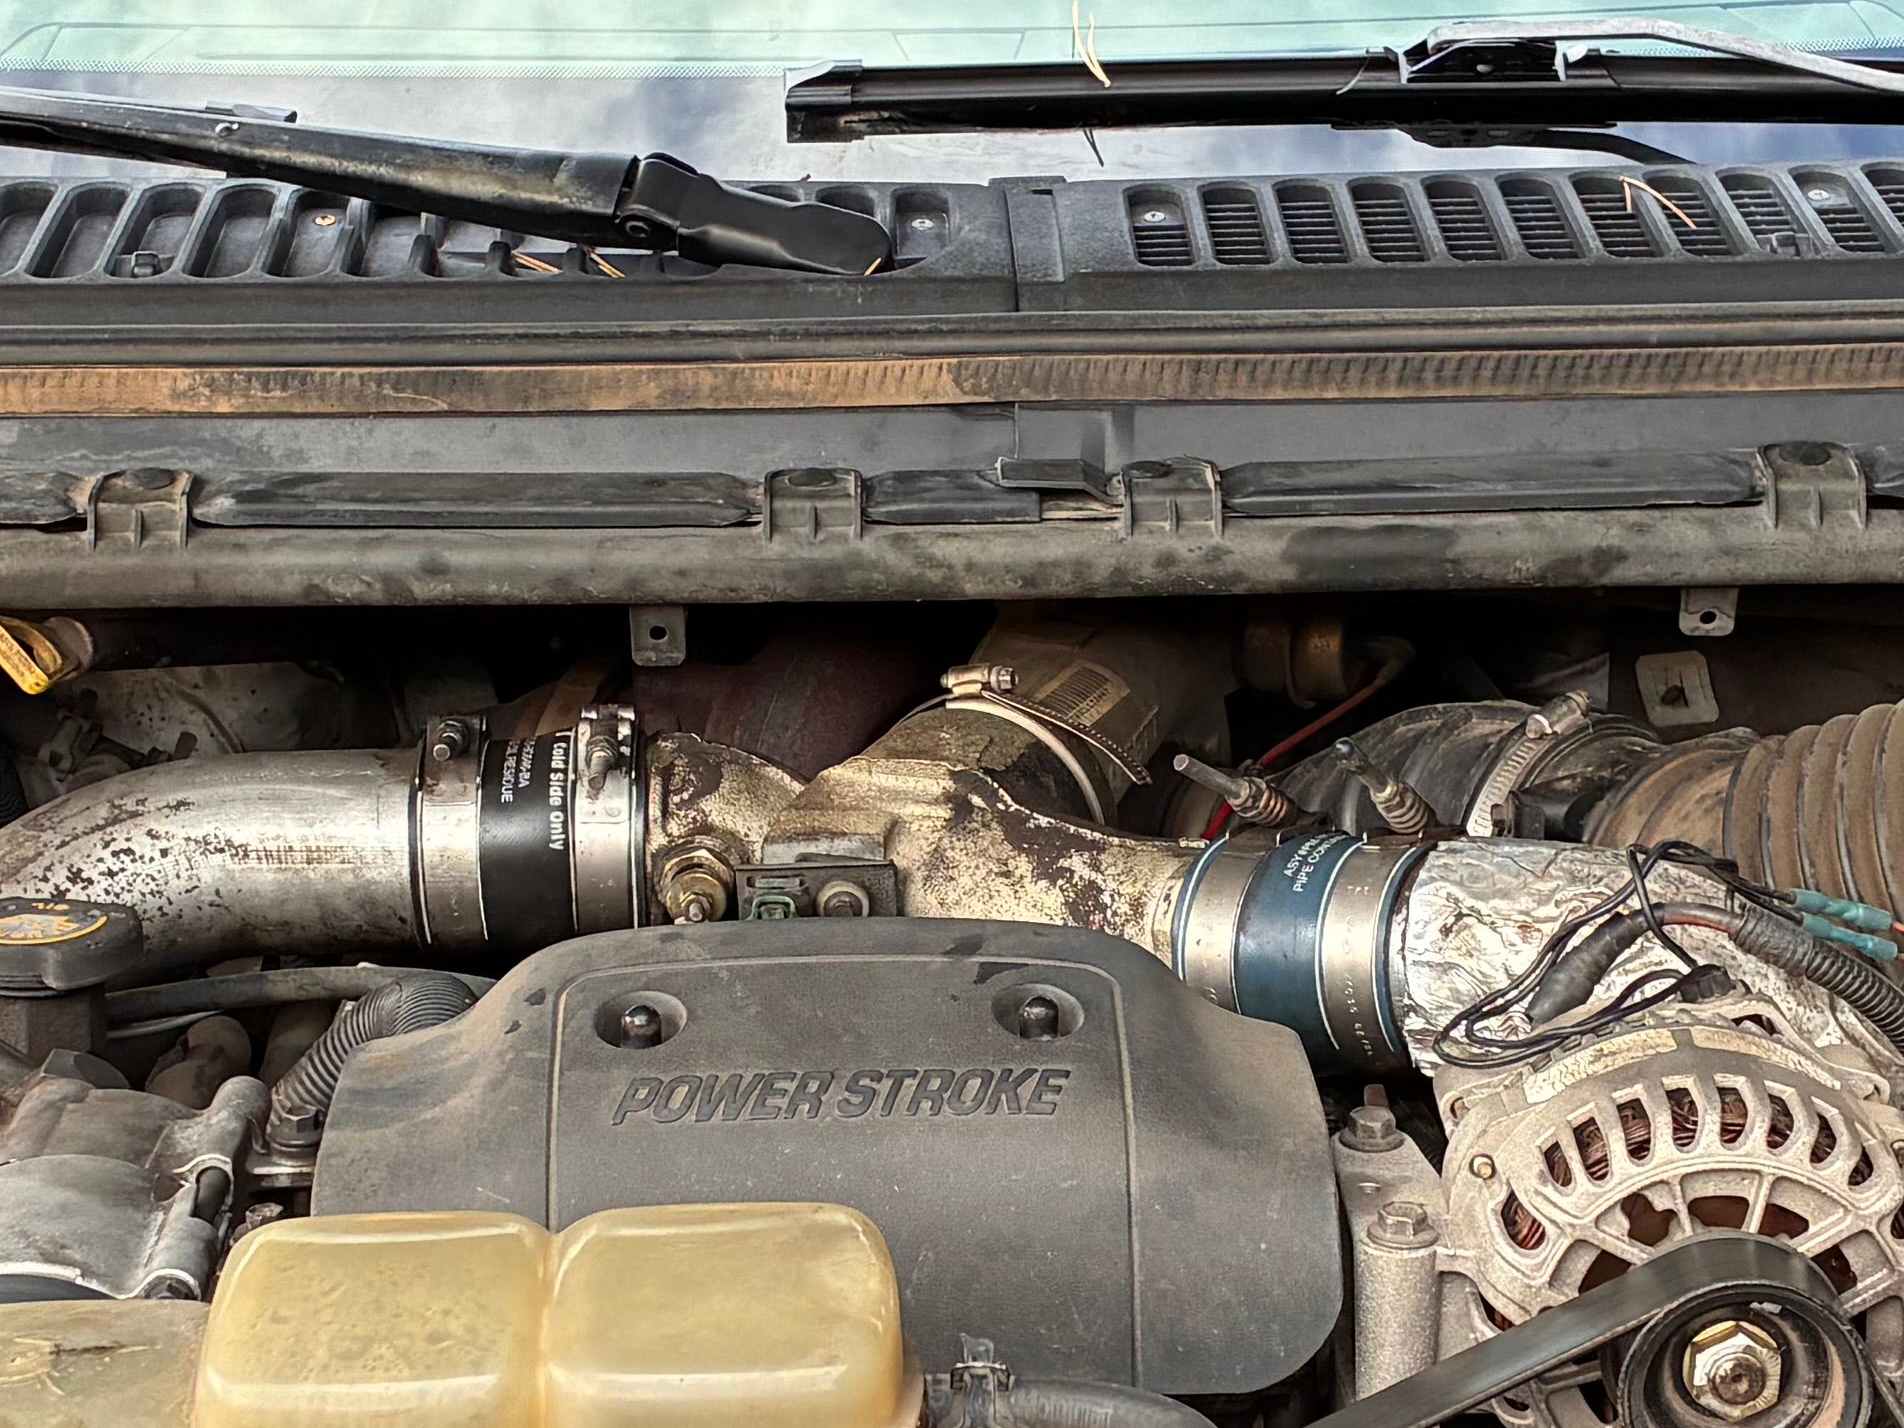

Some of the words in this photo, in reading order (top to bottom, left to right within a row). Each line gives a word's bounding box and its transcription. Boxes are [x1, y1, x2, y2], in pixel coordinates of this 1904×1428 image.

[549, 772, 564, 806] Side
[549, 811, 566, 850] Only
[1293, 865, 1314, 892] PIPE
[612, 1071, 834, 1125] POWER
[828, 1068, 1071, 1122] STROKE
